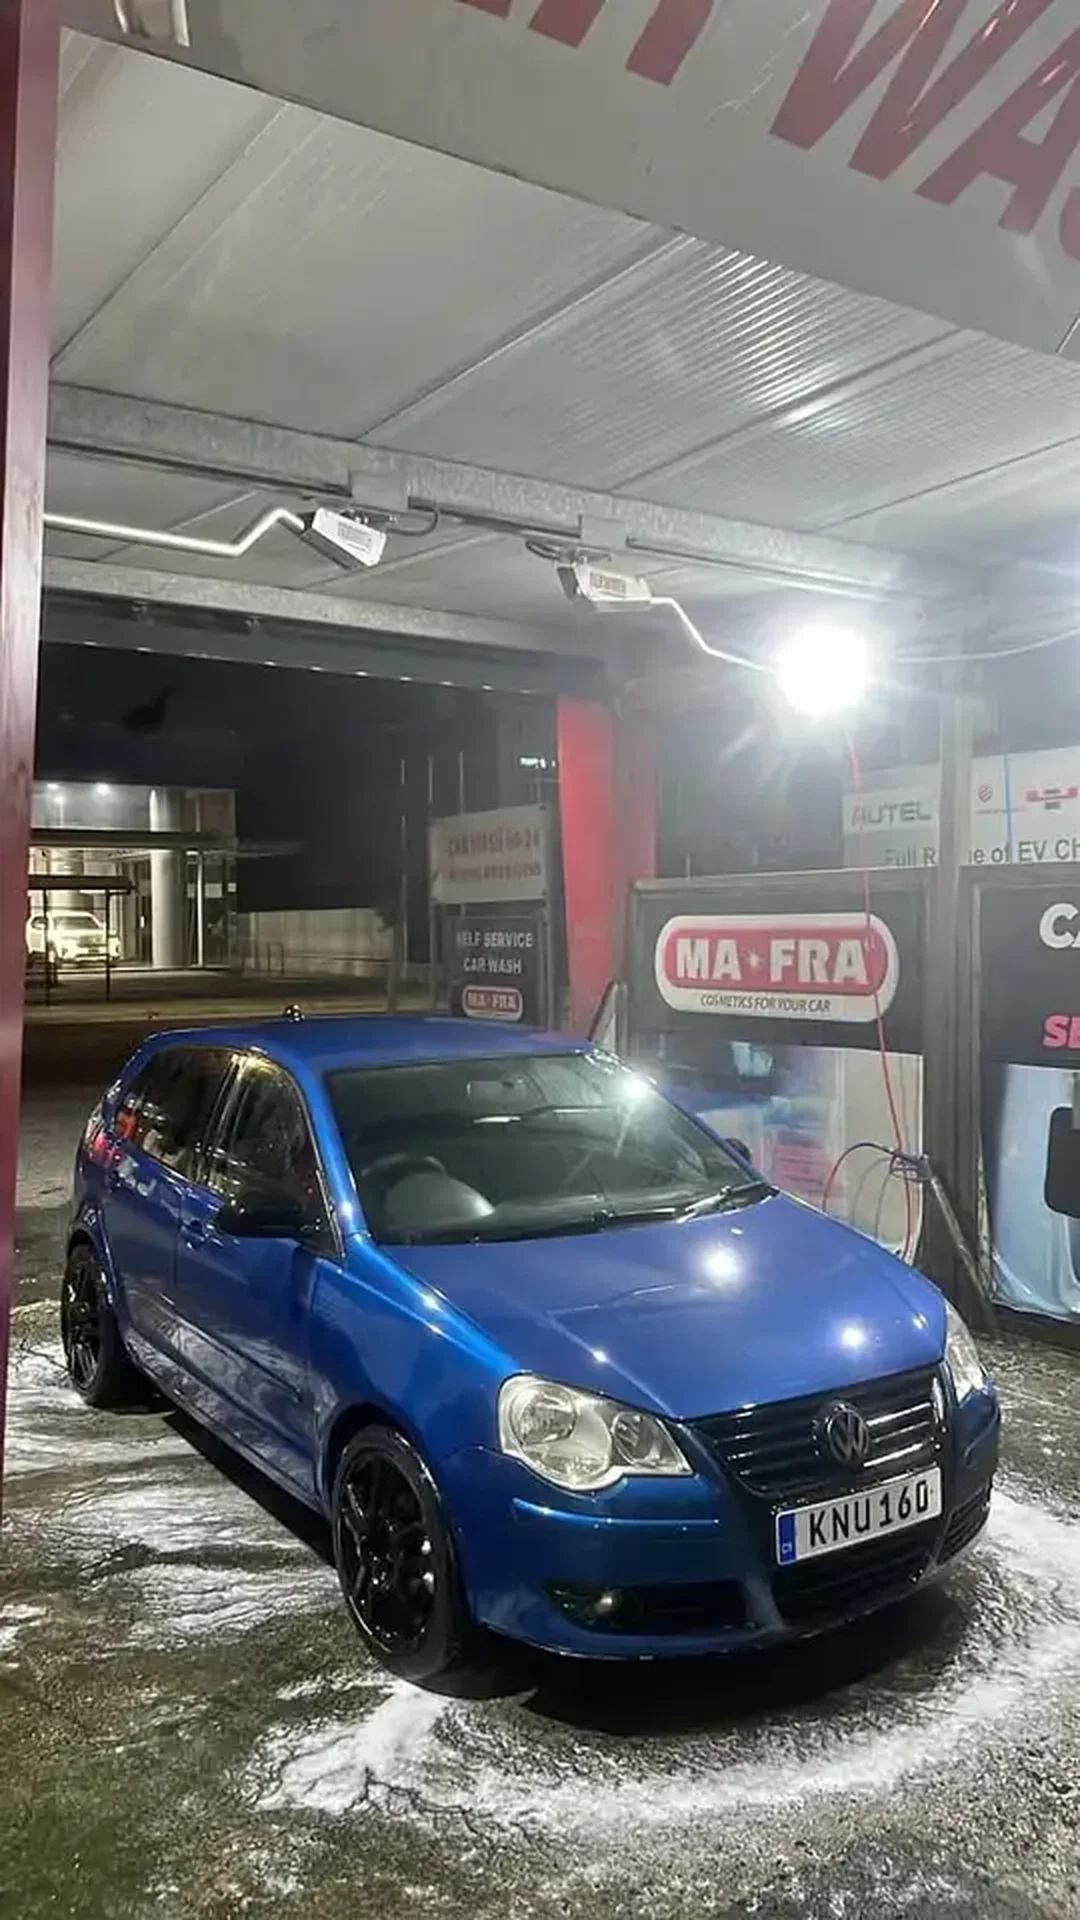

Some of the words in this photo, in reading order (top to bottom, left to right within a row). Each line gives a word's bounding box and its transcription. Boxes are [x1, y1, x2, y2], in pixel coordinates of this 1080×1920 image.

[769, 0, 1080, 262] WA
[852, 801, 932, 826] AUTEL
[885, 846, 916, 866] Full
[1019, 839, 1047, 862] EV
[484, 931, 533, 948] SERVICE
[463, 957, 487, 972] CAR
[488, 959, 522, 974] WASH
[676, 938, 742, 981] MA
[769, 939, 869, 985] FRA
[700, 994, 753, 1010] COSMETICS
[754, 997, 778, 1012] FOR
[778, 999, 808, 1013] YOUR
[808, 1000, 832, 1014] CAR
[809, 1498, 871, 1548] KNU
[878, 1479, 930, 1528] 160
